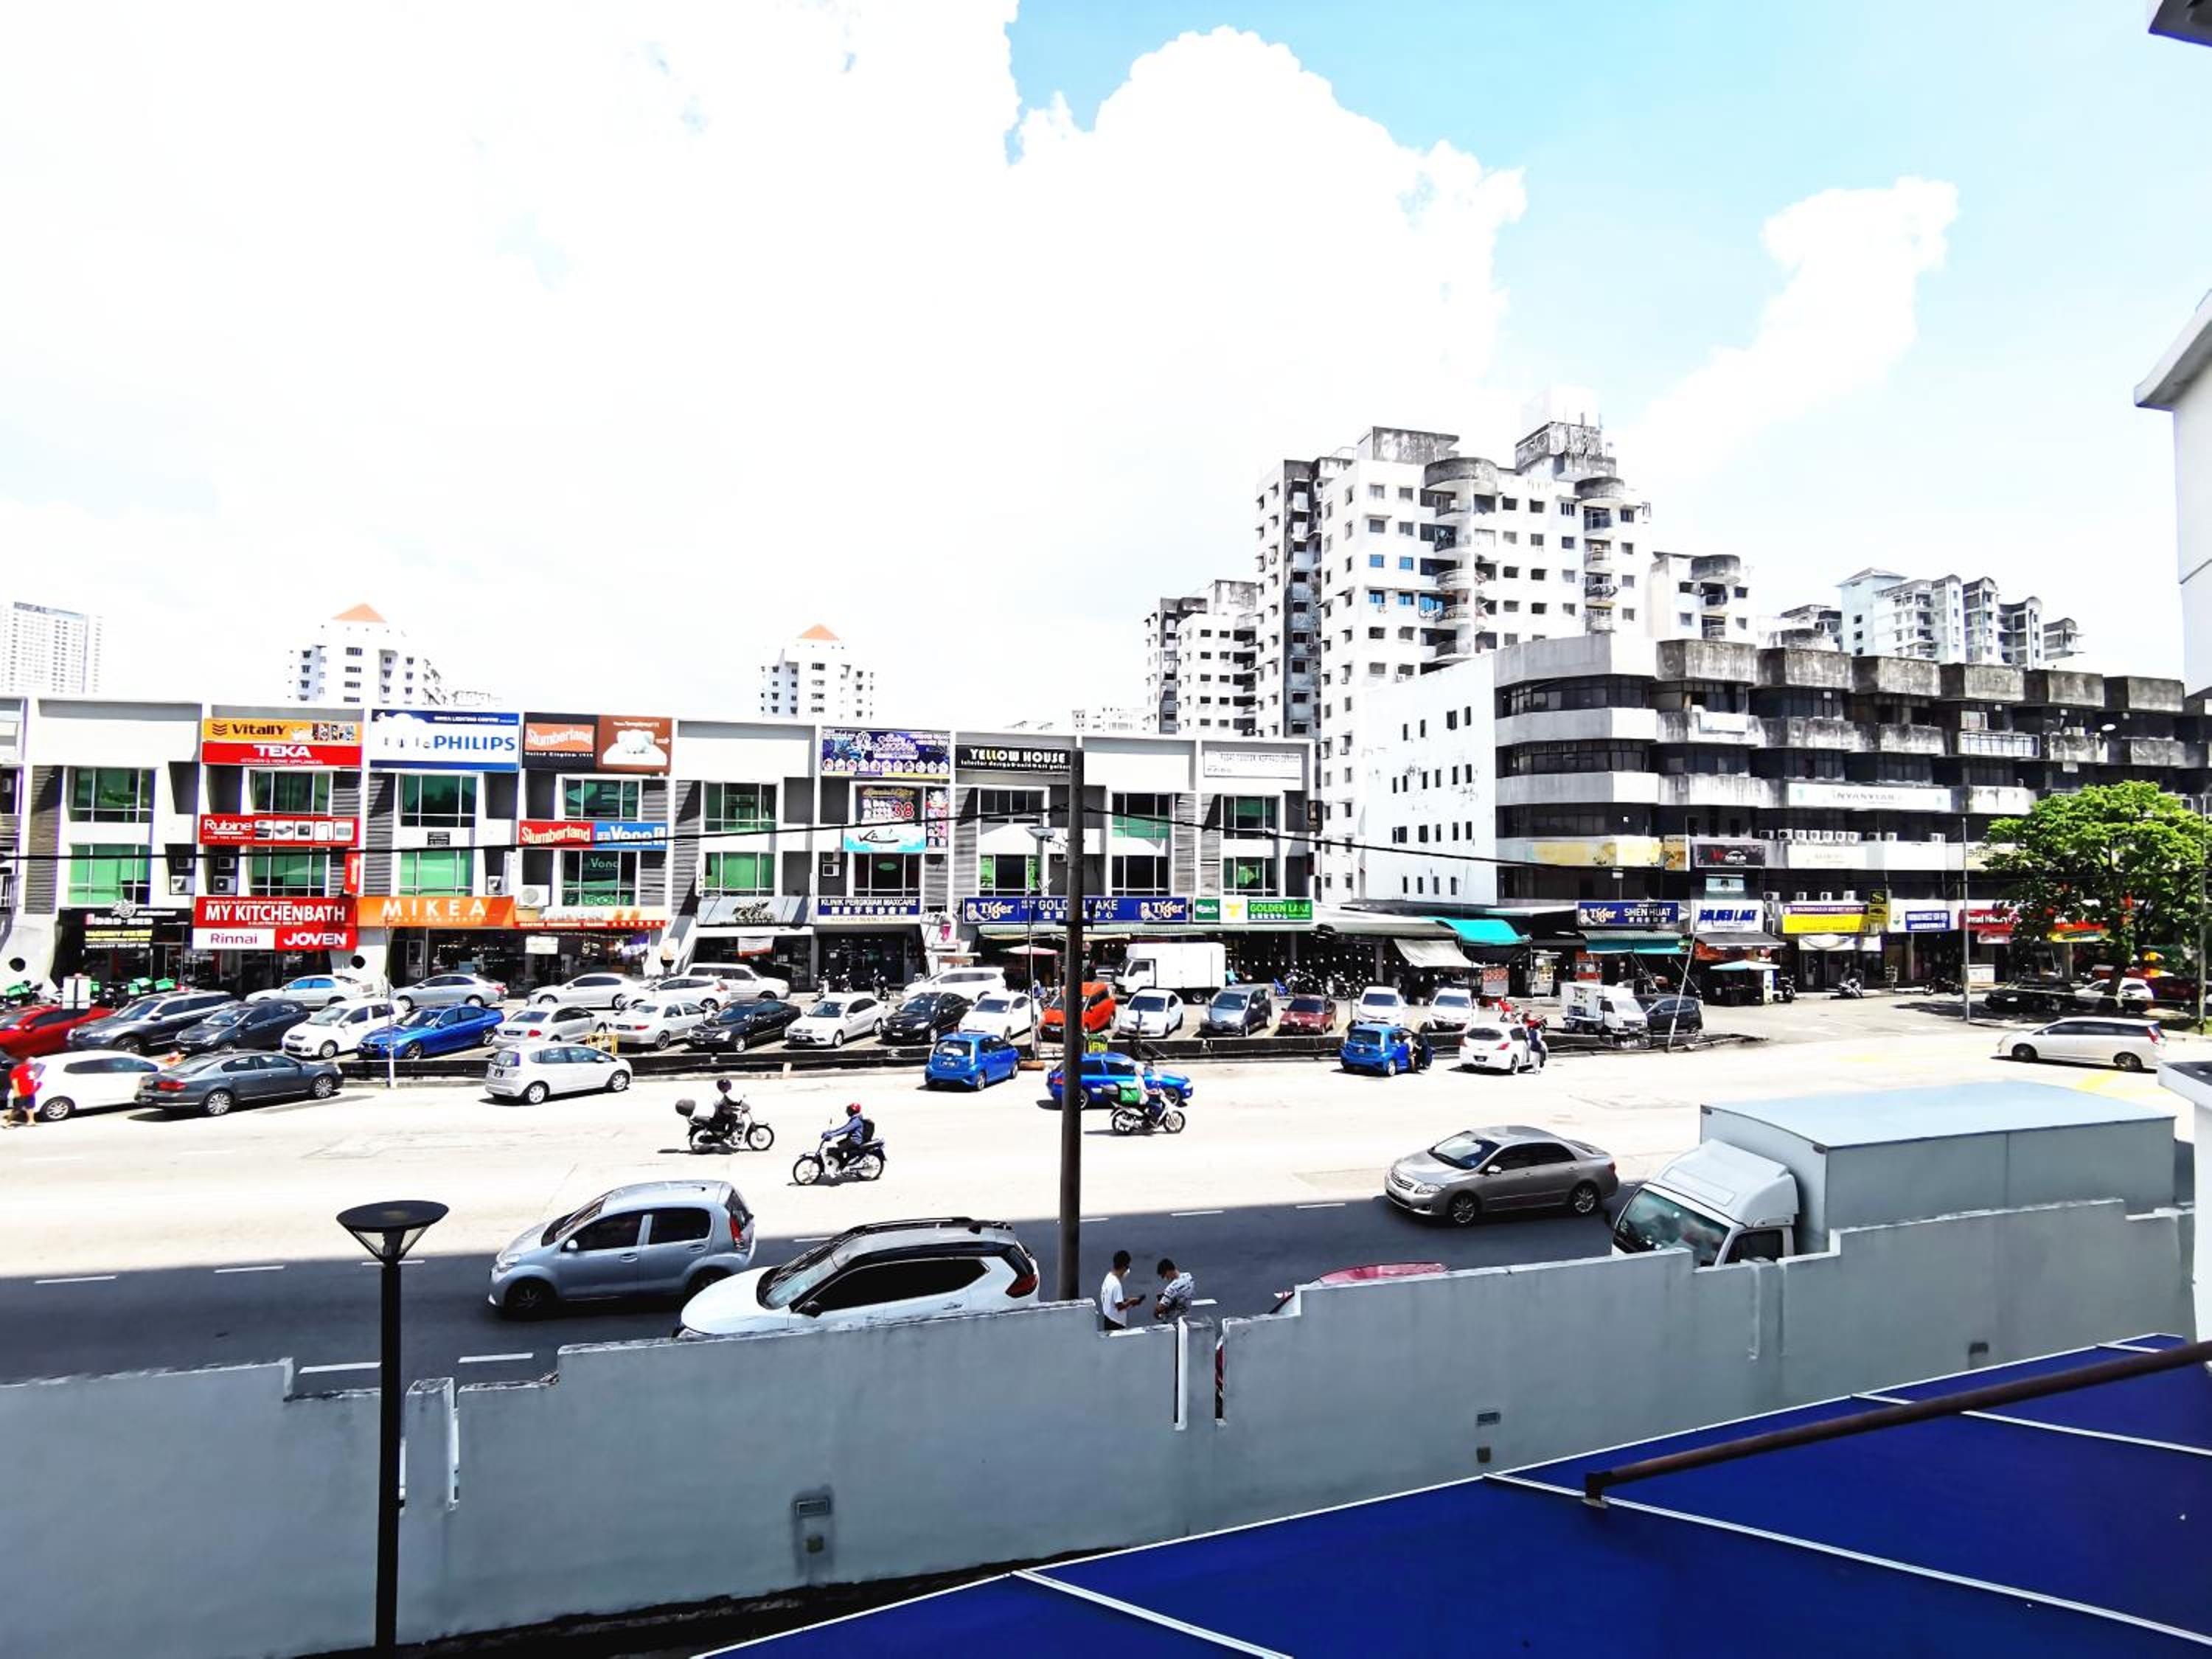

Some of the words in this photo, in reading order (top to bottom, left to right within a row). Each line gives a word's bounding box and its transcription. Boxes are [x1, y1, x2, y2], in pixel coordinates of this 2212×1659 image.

[253, 744, 311, 758] TEKA
[434, 735, 516, 751] PHILIPS
[970, 748, 1020, 762] YELLOW
[1023, 751, 1065, 764] HOUSE
[204, 818, 253, 832] Rubine
[521, 824, 591, 845] Slumberland
[205, 905, 232, 921] MY
[234, 905, 346, 922] KITCHENBATH
[380, 899, 487, 917] MIKEA
[978, 900, 1015, 919] Tiger
[1152, 900, 1185, 919] Tiger
[1250, 903, 1286, 913] GOLDEN
[1589, 907, 1617, 923] Tiger
[1624, 908, 1648, 917] SHEN
[1649, 908, 1672, 917] HUAT
[210, 933, 258, 945] Rinnai
[283, 931, 347, 947] JOVEN
